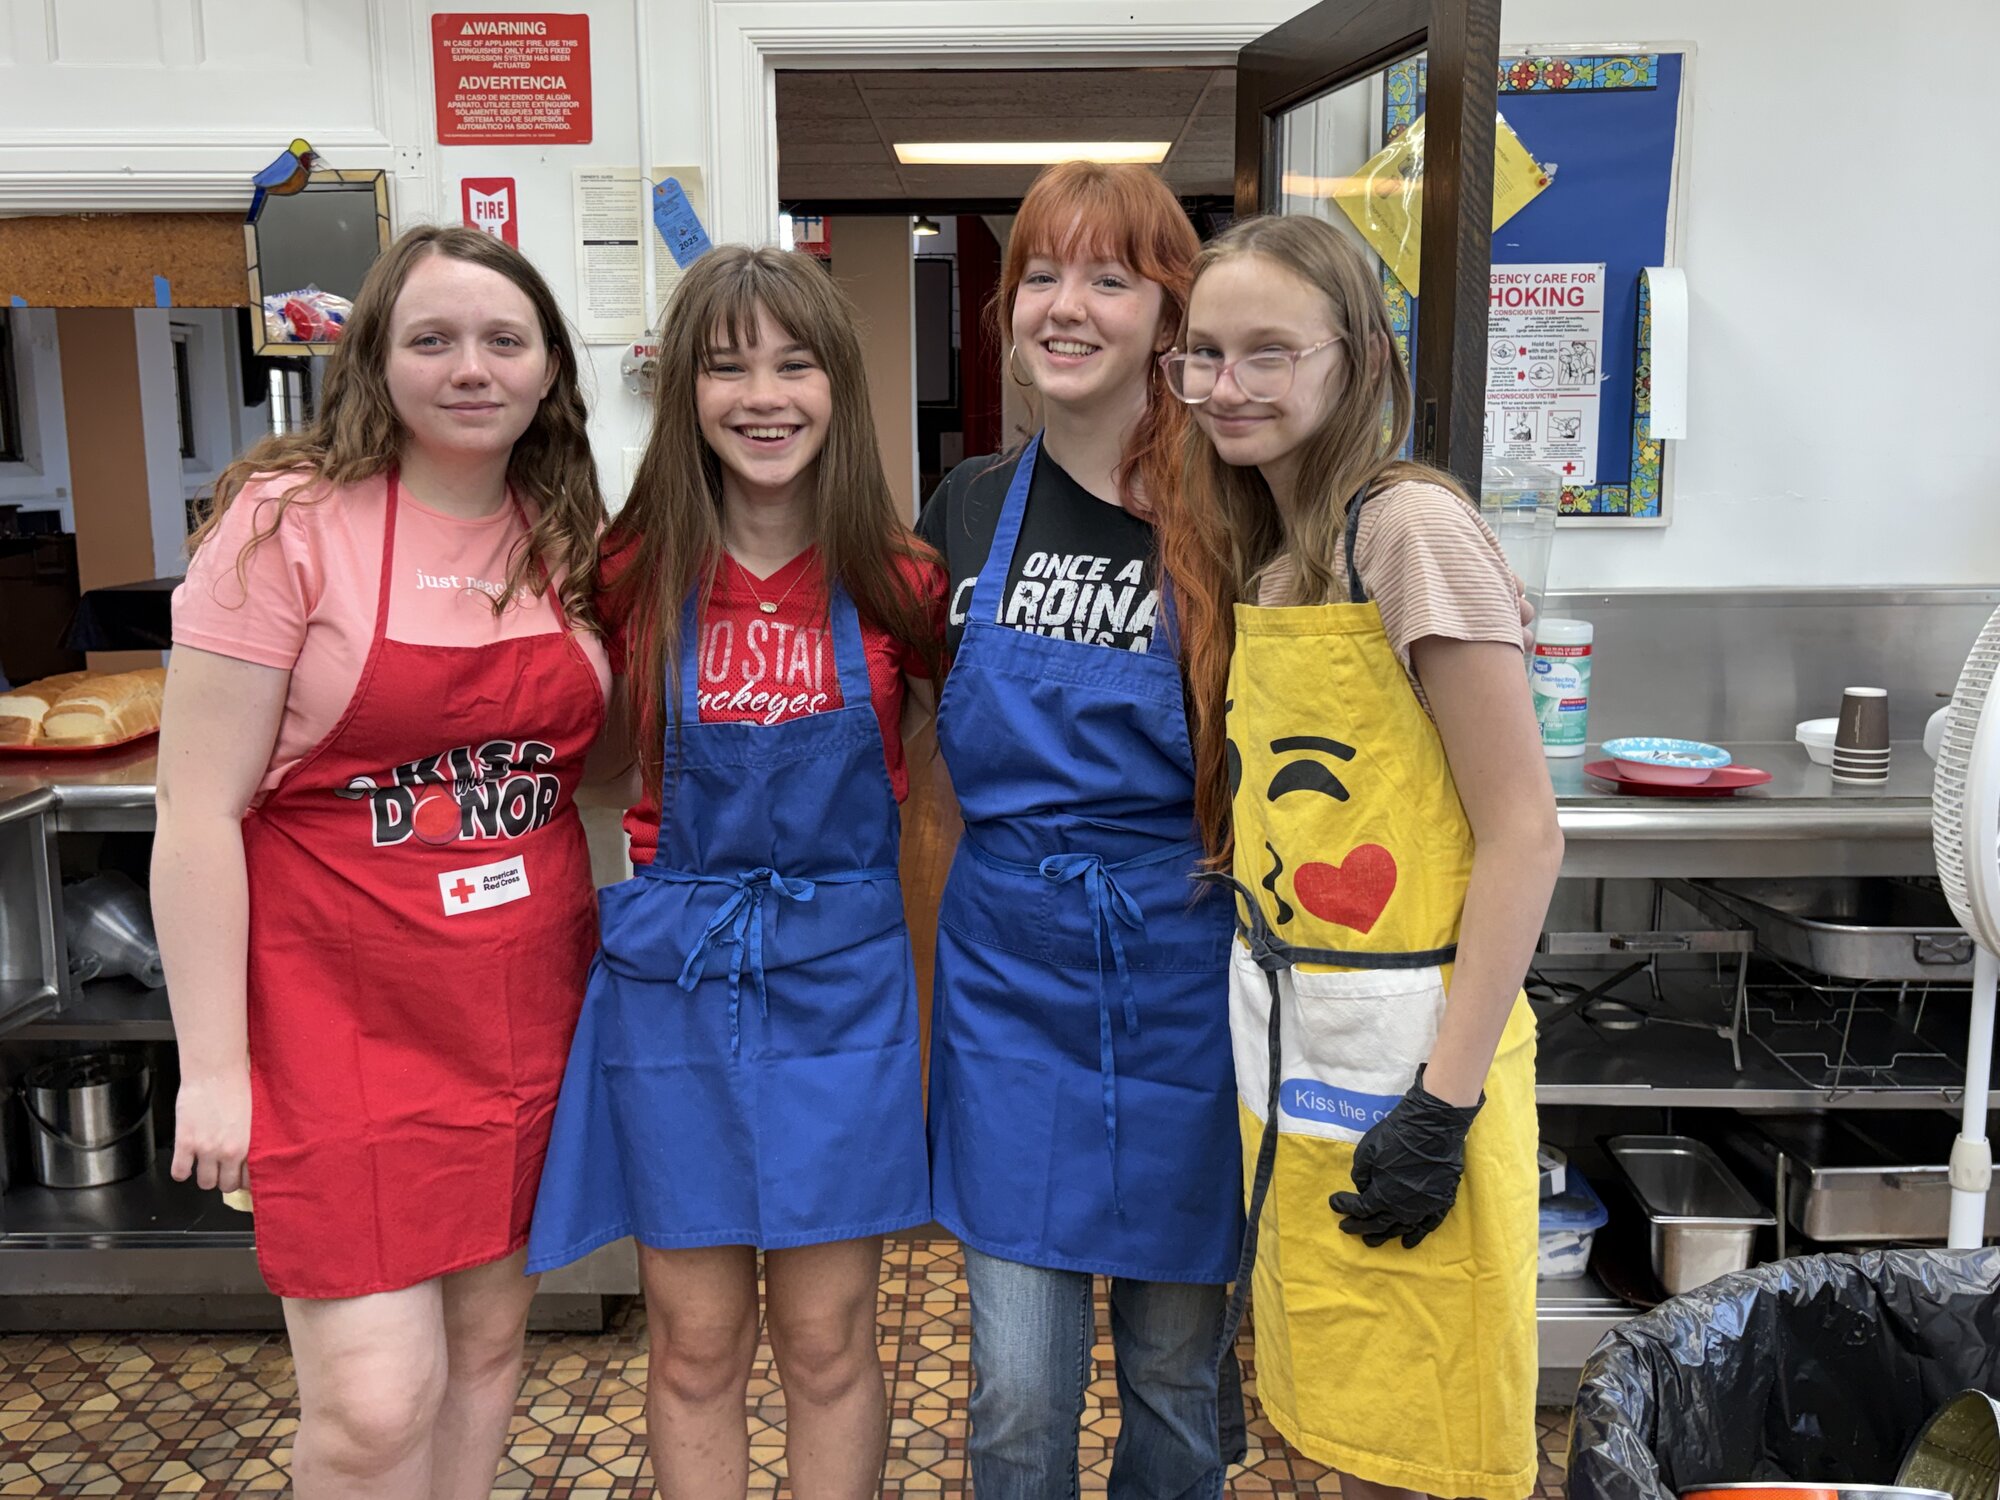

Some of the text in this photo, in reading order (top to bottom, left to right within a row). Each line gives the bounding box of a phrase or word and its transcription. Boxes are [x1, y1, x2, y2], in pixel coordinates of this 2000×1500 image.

[474, 22, 546, 35] WARNING
[458, 76, 567, 90] ADVERTENCIA
[476, 201, 504, 219] FIRE
[679, 235, 699, 251] 2025
[1489, 273, 1595, 284] GENCY CARE FOR
[1489, 286, 1584, 307] HOKING
[1022, 552, 1144, 585] ONCE A
[416, 568, 461, 589] just
[950, 576, 1159, 634] CRDINA
[696, 680, 827, 725] uckeyes
[483, 869, 518, 883] American
[484, 876, 520, 891] Red Cross
[1295, 1089, 1335, 1112] Kiss
[1339, 1100, 1366, 1121] the
